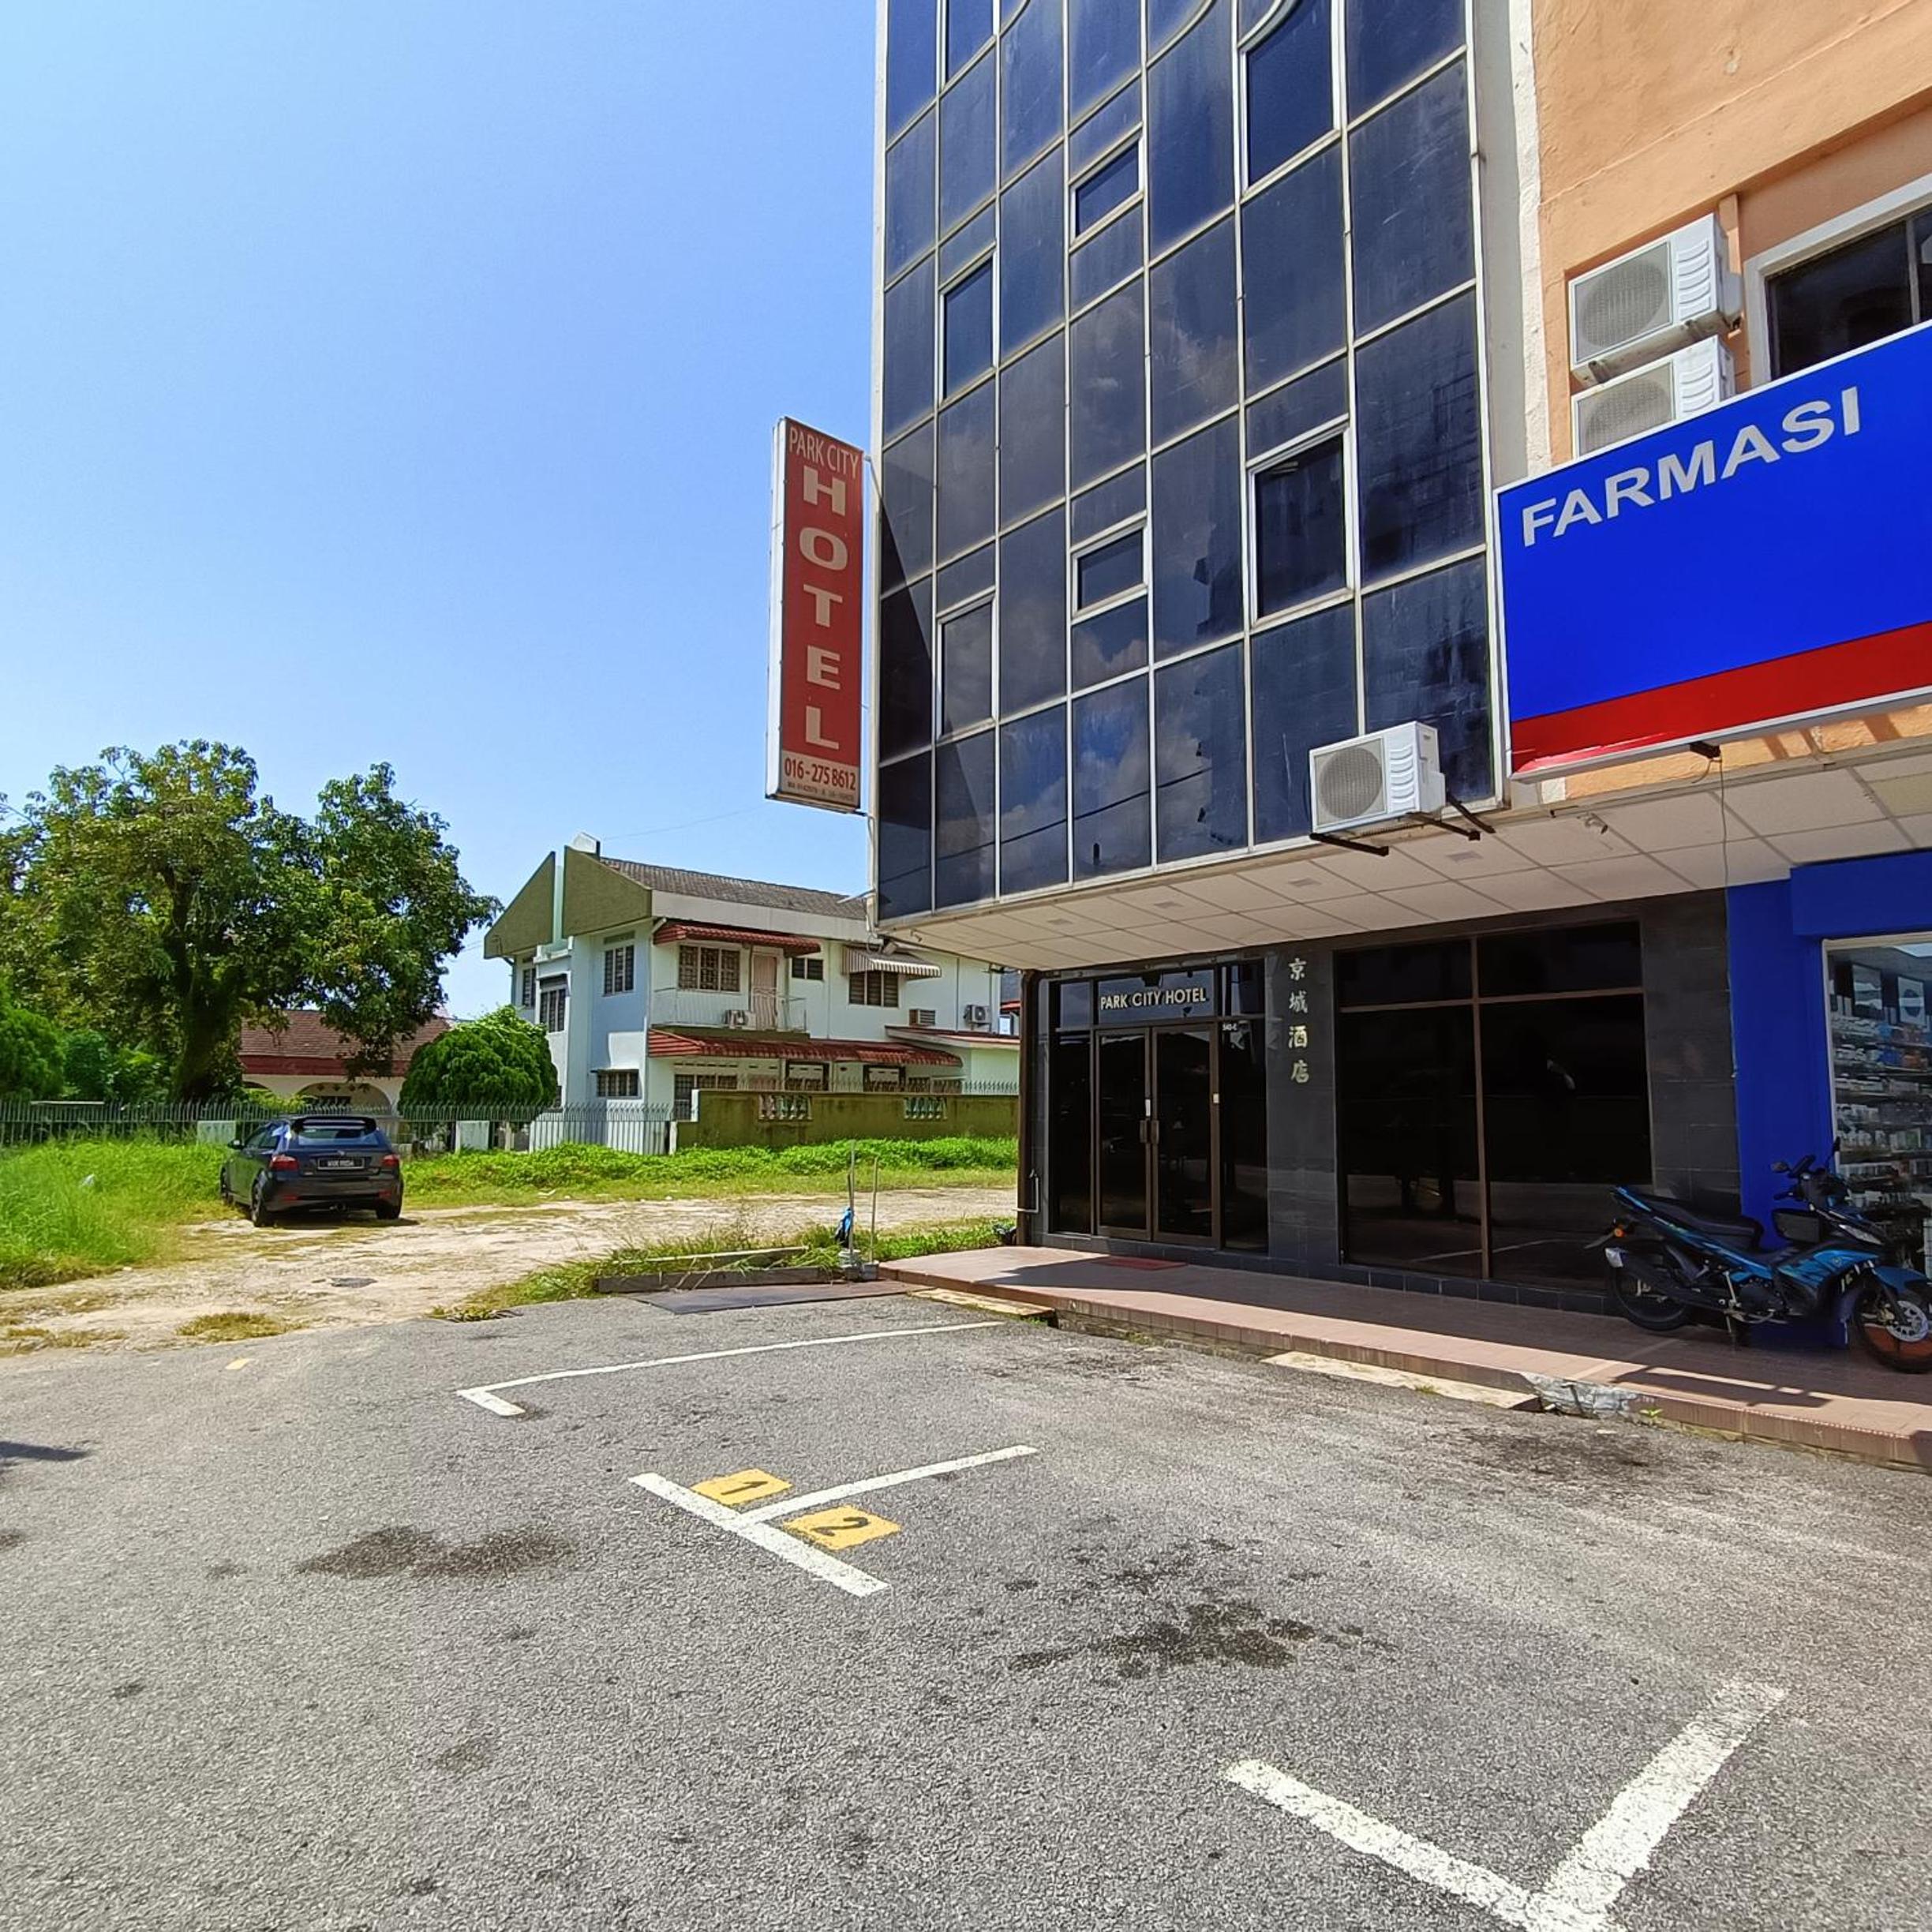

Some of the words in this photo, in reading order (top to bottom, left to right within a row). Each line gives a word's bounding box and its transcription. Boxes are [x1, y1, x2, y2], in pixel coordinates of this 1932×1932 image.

[789, 426, 825, 466] PARK
[827, 444, 859, 479] CITY
[1521, 386, 1861, 548] FARMASI
[799, 465, 848, 751] HOTEL
[1100, 994, 1129, 1011] PARK
[1132, 990, 1162, 1007] CITY
[1166, 987, 1207, 1005] HOTEL
[1288, 957, 1310, 1084] 京城酒店
[720, 1480, 769, 1496] 1
[811, 1516, 870, 1537] 2
